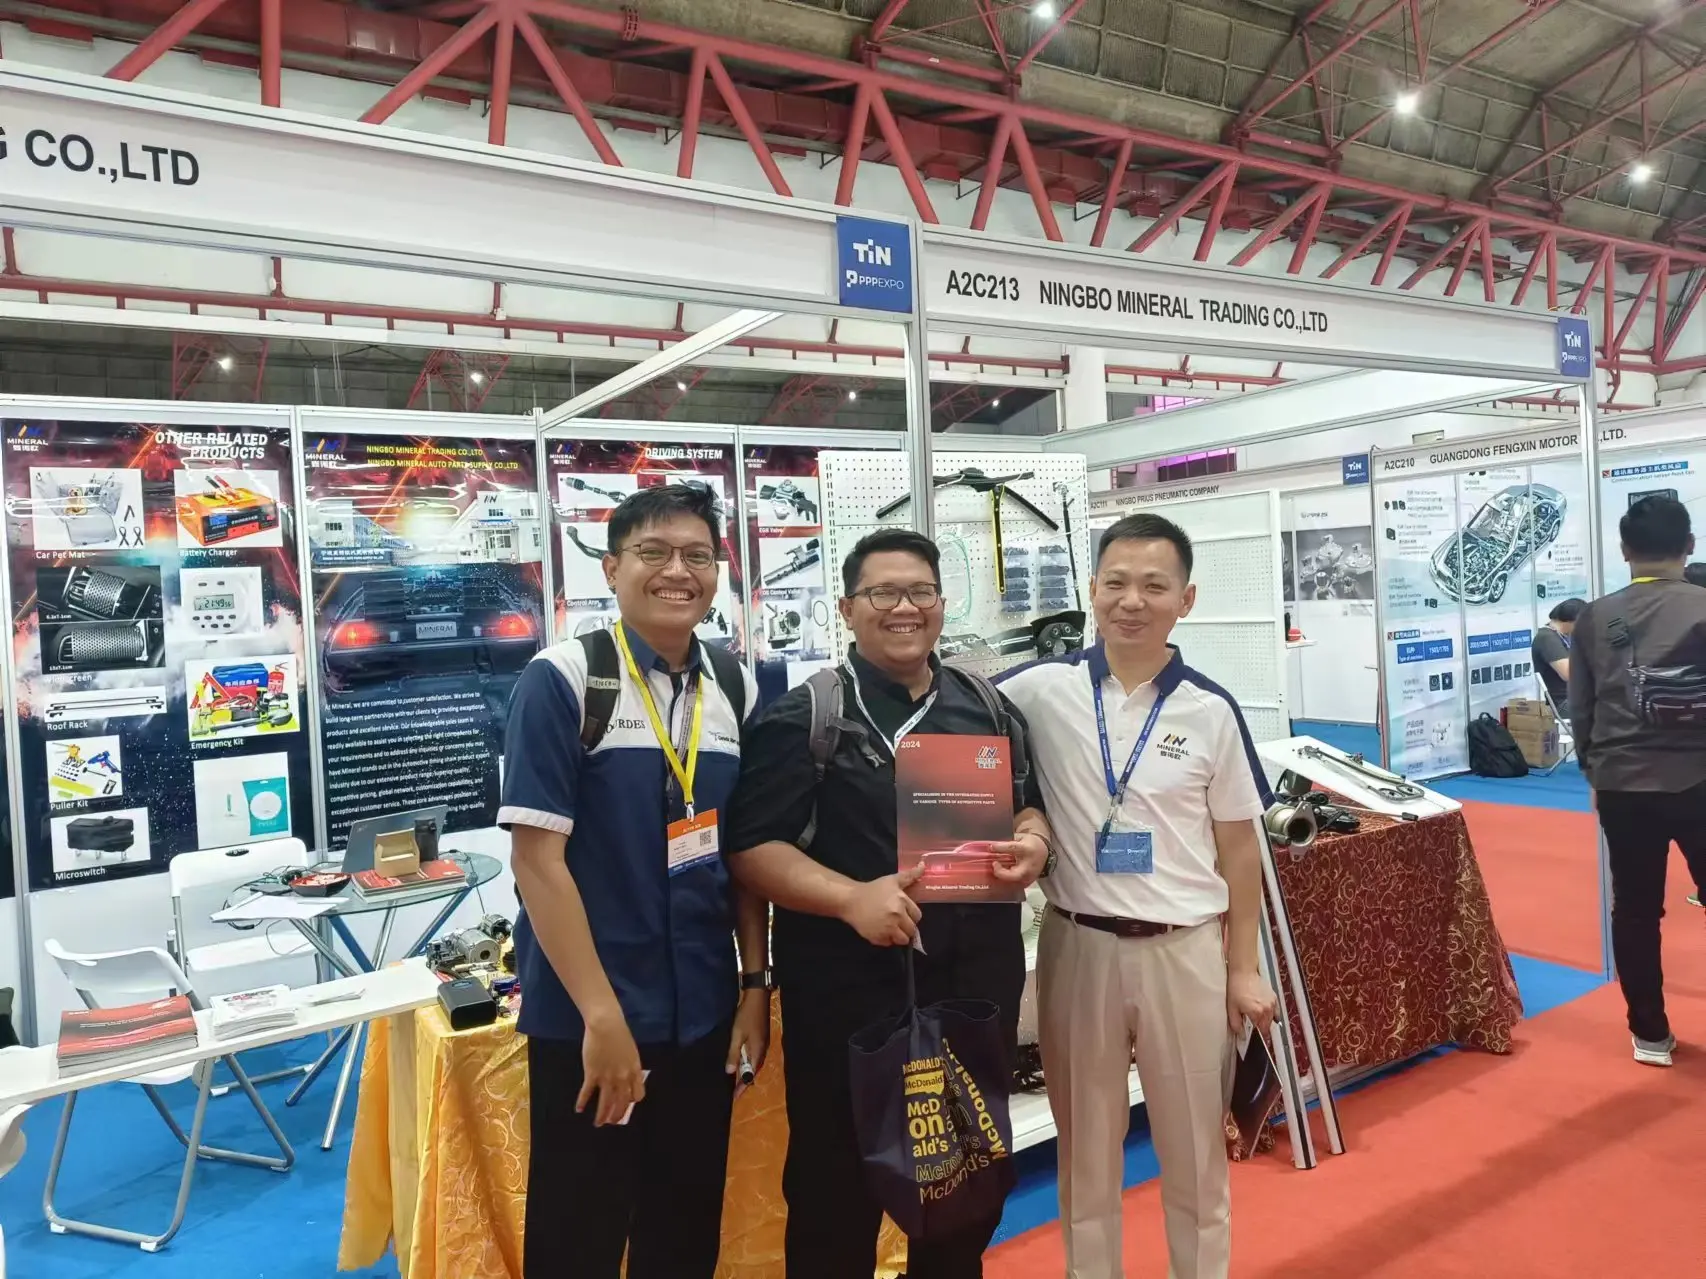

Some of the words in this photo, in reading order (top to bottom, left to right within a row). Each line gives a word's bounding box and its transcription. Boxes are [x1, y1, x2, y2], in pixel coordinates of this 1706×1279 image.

[25, 129, 200, 186] CO.,LTD
[852, 238, 892, 266] TiN
[946, 269, 1020, 301] A2C213
[1040, 280, 1112, 311] NINGBO
[1117, 289, 1194, 320] MINERAL
[1199, 299, 1269, 327] TRADING
[1273, 307, 1328, 334] CO.,LTD
[6, 438, 49, 446] MINERAL
[155, 431, 202, 445] OTHER
[207, 432, 268, 445] RELATED
[190, 446, 265, 460] PRODUCTS
[305, 453, 347, 461] MINERAL
[366, 445, 394, 454] NINGBO
[395, 447, 426, 455] MINERAL
[427, 448, 457, 456] TRADING
[645, 448, 684, 459] DRIVING
[686, 449, 723, 459] SYSTEM
[1384, 457, 1415, 470] A2C210
[1429, 447, 1491, 465] GUANGDONG
[1493, 442, 1537, 457] FENGXIN
[1539, 434, 1578, 452] MOTOR
[367, 459, 395, 467] NINGBO
[396, 460, 428, 468] MINERAL
[1116, 496, 1136, 506] NINGBO
[1155, 489, 1188, 501] PNEUMATIC
[1189, 485, 1220, 496] COMPANY
[36, 550, 52, 559] Car
[53, 550, 69, 559] Pet
[70, 550, 86, 559] Mat
[208, 548, 238, 558] Charger
[46, 720, 67, 731] Roof
[69, 720, 88, 730] Rack
[327, 727, 349, 737] products
[191, 738, 232, 750] Emergency
[234, 737, 244, 747] Kit
[901, 740, 921, 748] 2024
[1156, 743, 1190, 756] MINERAL
[50, 800, 75, 811] Puller
[77, 798, 89, 808] Kit
[55, 866, 106, 881] Microswitch
[907, 1098, 941, 1118] McD
[909, 1113, 945, 1139] on
[912, 1137, 949, 1158] ald's
